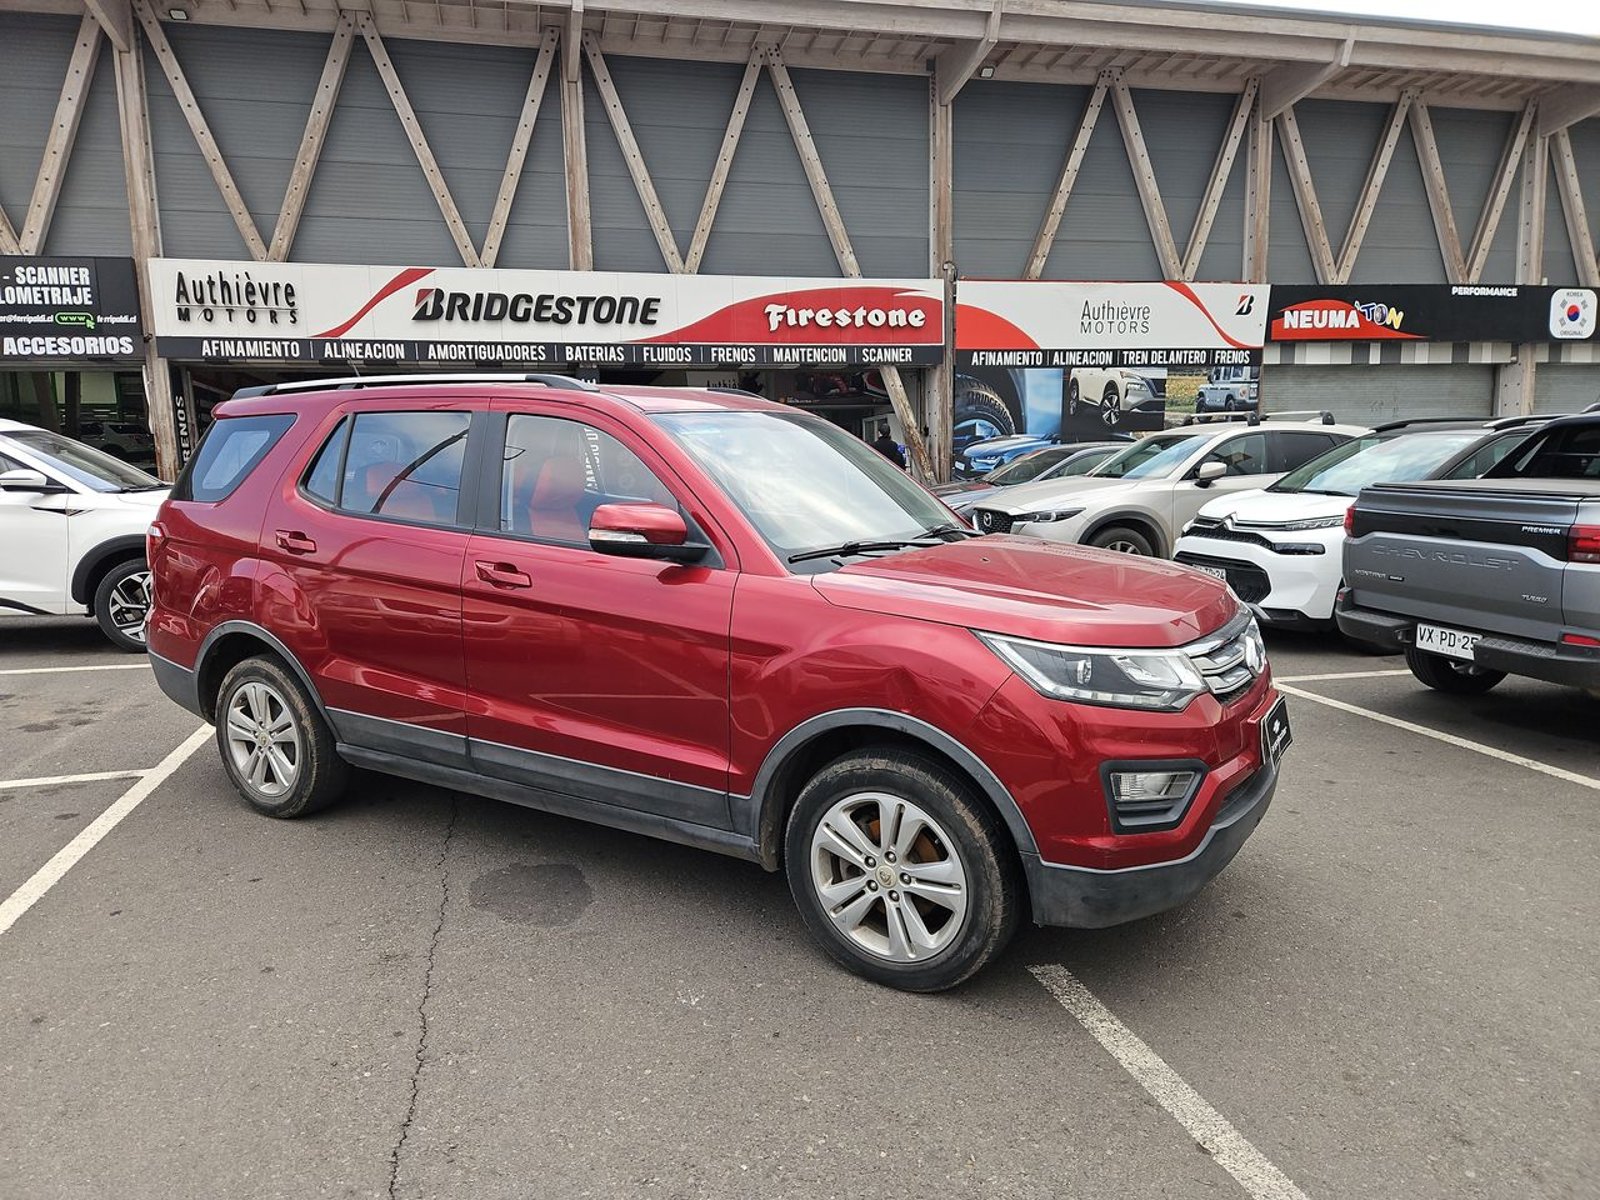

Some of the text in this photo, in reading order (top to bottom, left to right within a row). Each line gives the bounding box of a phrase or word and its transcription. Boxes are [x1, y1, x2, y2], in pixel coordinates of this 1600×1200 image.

[15, 266, 90, 285] SCANNER
[175, 270, 296, 307] Authièvre
[1452, 286, 1518, 297] PERFORMANCE
[176, 307, 298, 324] MOTORS
[412, 288, 661, 325] BRIDGESTONE
[1081, 300, 1151, 320] Authièvre
[764, 303, 927, 333] Firestone
[1080, 321, 1150, 335] MOTORS
[3, 336, 134, 356] ACCESORIOS
[202, 340, 913, 363] AFINAMIENTO ALINEACION AMORTIGUADORES BATERIAS FLUIDOS FRENOS MANTENCION SCANNER
[971, 350, 1251, 366] AFINAMIENTO ALINEACION TREN DELANTERO FRENOS
[175, 395, 192, 466] RENOS
[1521, 525, 1561, 535] PREMIER
[1371, 543, 1520, 571] CHEVROLET
